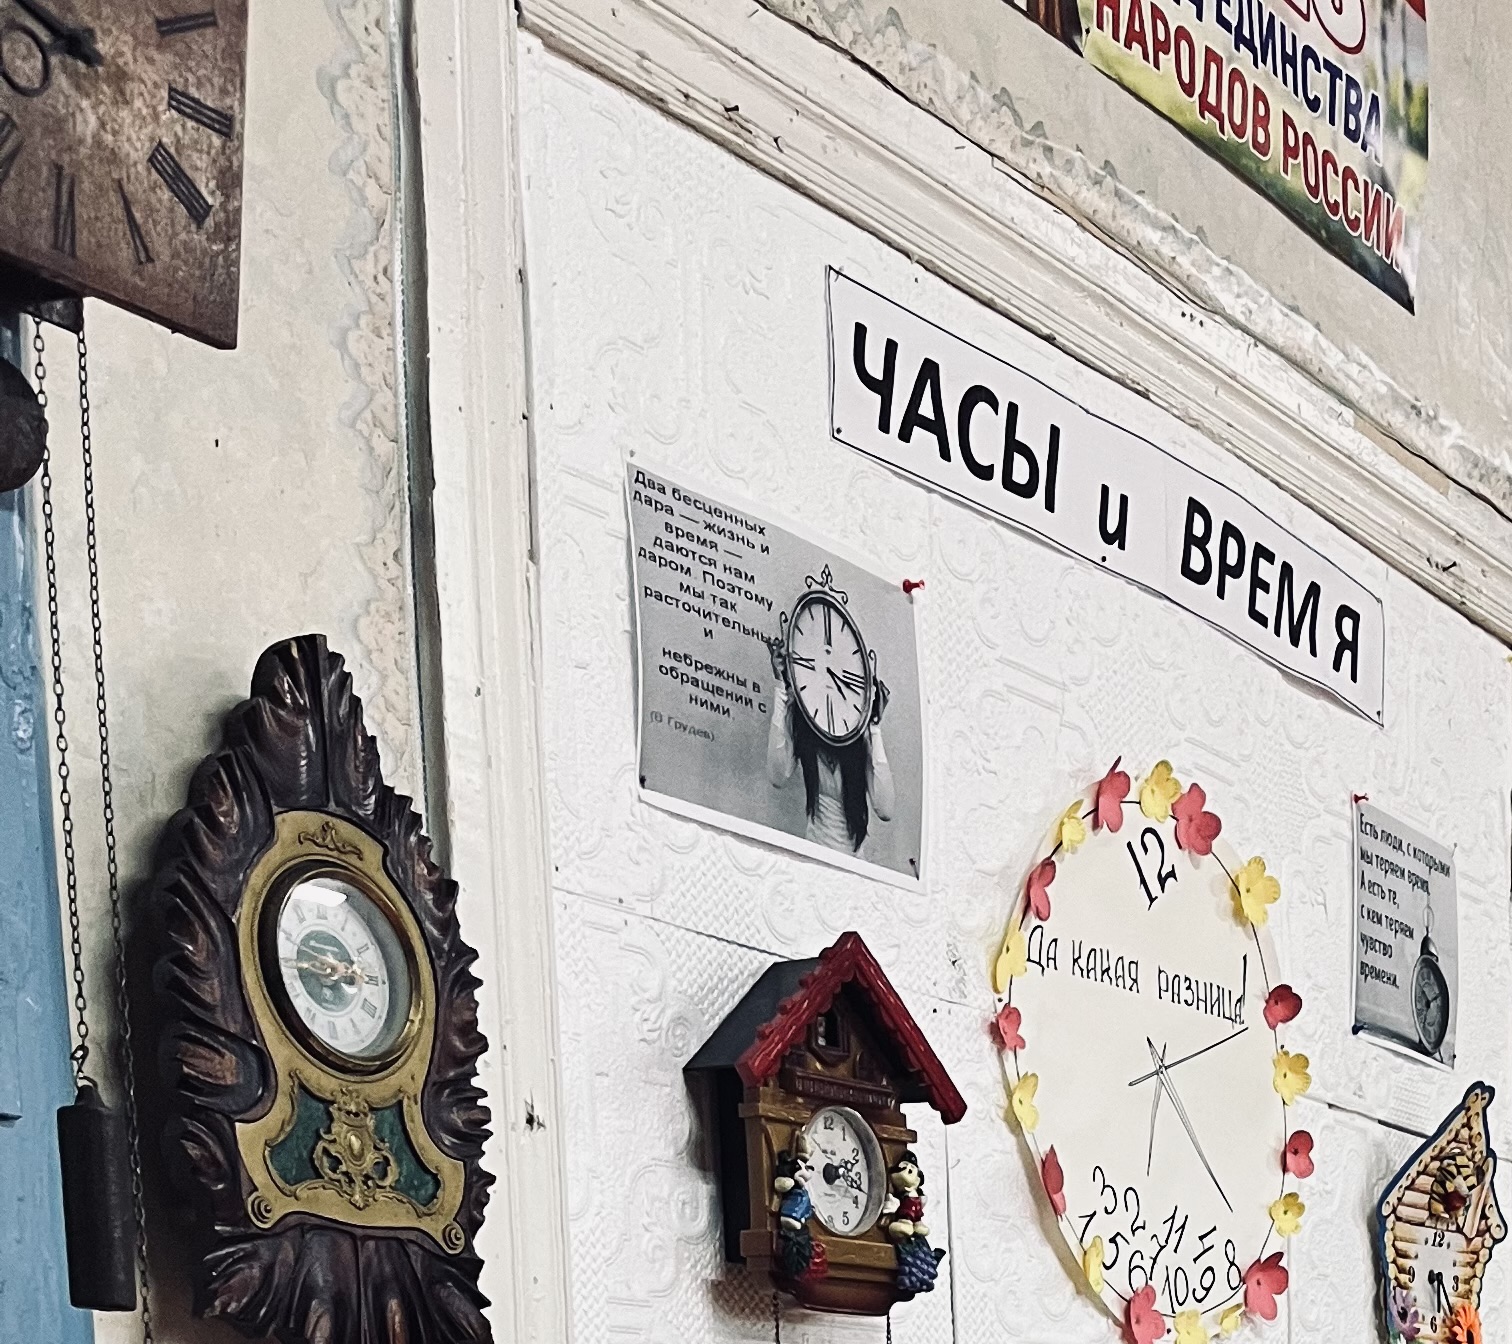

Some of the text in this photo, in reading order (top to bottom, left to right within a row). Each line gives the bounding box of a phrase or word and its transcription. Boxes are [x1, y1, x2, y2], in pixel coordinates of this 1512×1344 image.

[1097, 0, 1405, 271] НАРОДОВ РОССИИ
[633, 490, 770, 555] дара жизнь и
[634, 470, 766, 536] Два бесценных
[853, 322, 1361, 683] ЧАСЫ и ВРЕМЯ
[664, 522, 718, 552] время
[653, 536, 755, 585] даются нам
[679, 582, 737, 613] мы так
[702, 570, 773, 611] Поэтому
[644, 586, 772, 644] расточительны
[703, 627, 713, 639] и
[658, 664, 766, 713] обращении с
[662, 647, 761, 693] небрежны в
[1360, 813, 1378, 840] Есть
[1127, 827, 1178, 911] 12
[1360, 845, 1373, 866] мы
[1375, 854, 1405, 881] теряем
[1360, 870, 1366, 891] А
[1368, 879, 1386, 900] есть
[1367, 907, 1382, 927] кем
[1385, 914, 1414, 940] теряем
[1360, 932, 1392, 958] чувство
[1092, 1166, 1117, 1215] 3
[1124, 1187, 1145, 1236] 2
[1432, 1231, 1445, 1247] 12
[1224, 1239, 1243, 1290] 8
[1408, 1266, 1415, 1283] 9
[1452, 1275, 1459, 1292] 3
[1430, 1316, 1437, 1333] 6
